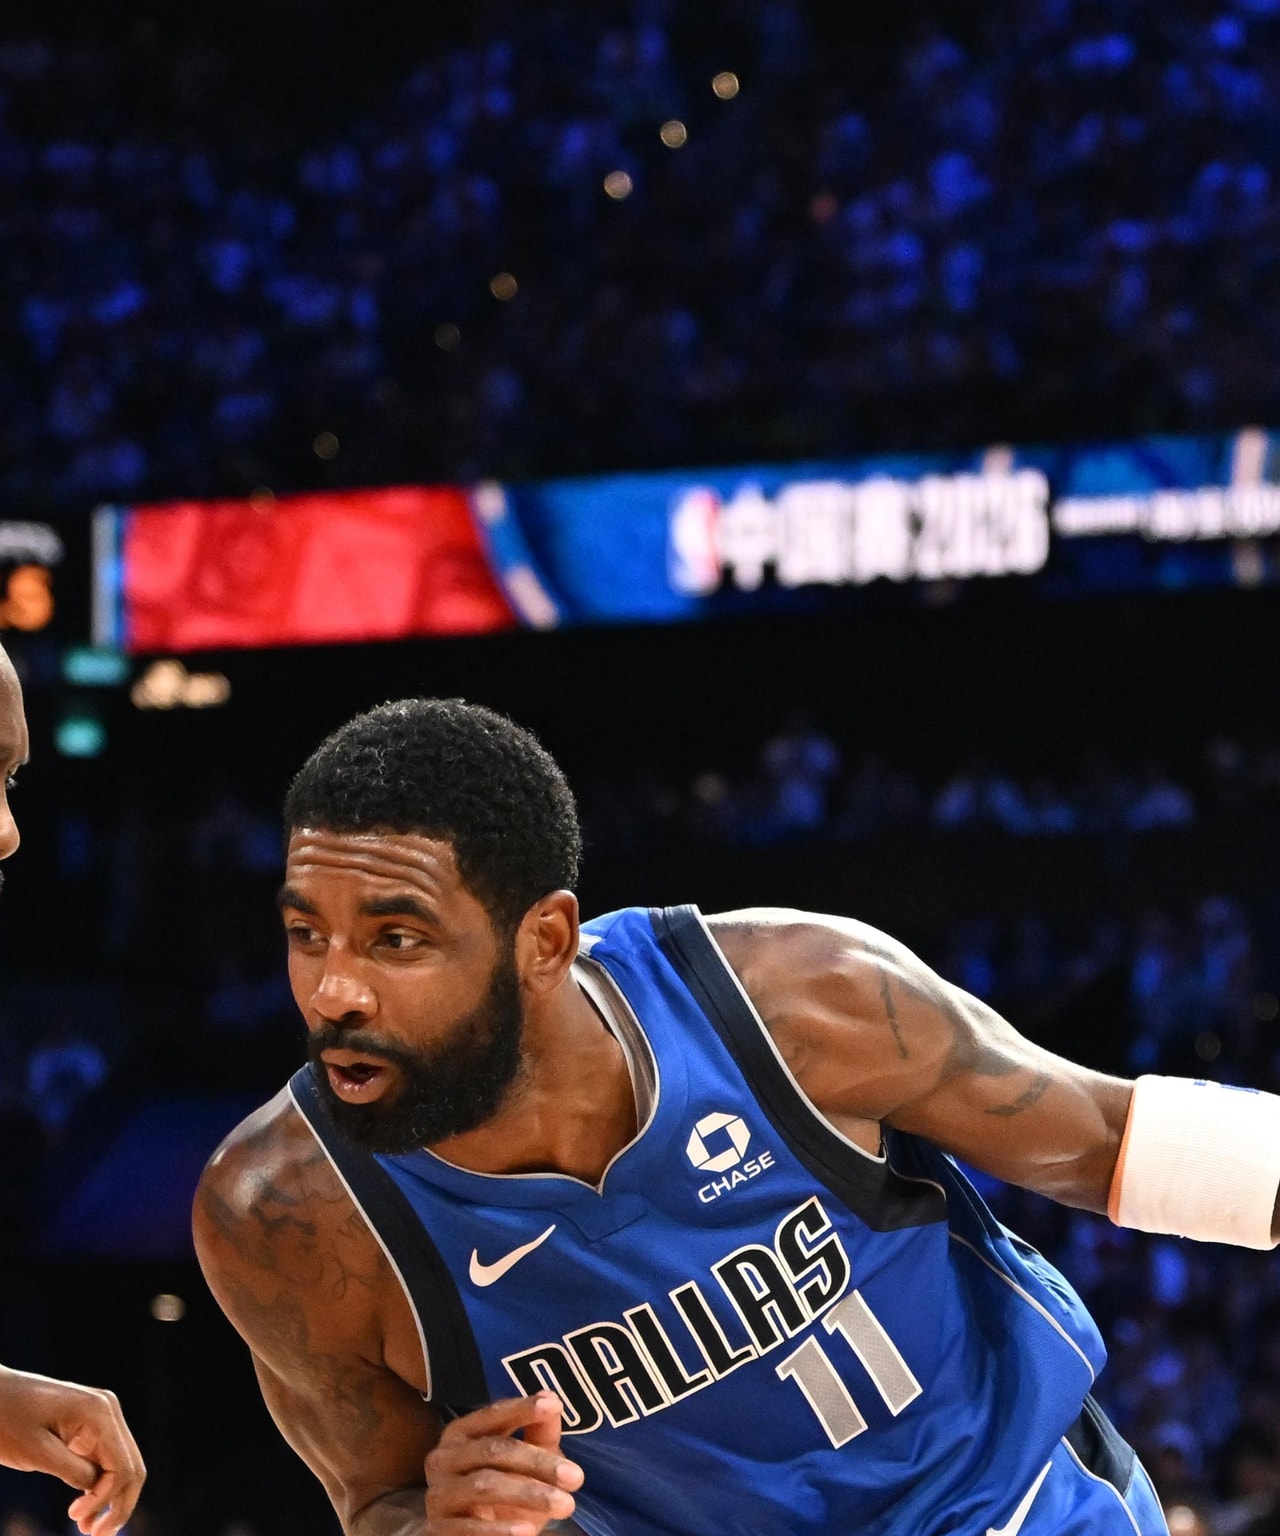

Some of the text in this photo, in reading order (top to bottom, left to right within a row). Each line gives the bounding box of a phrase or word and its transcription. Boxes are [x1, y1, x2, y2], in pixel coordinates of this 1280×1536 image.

[698, 1150, 776, 1203] CHASE
[501, 1196, 851, 1436] DALLAS
[775, 1289, 923, 1450] 11
